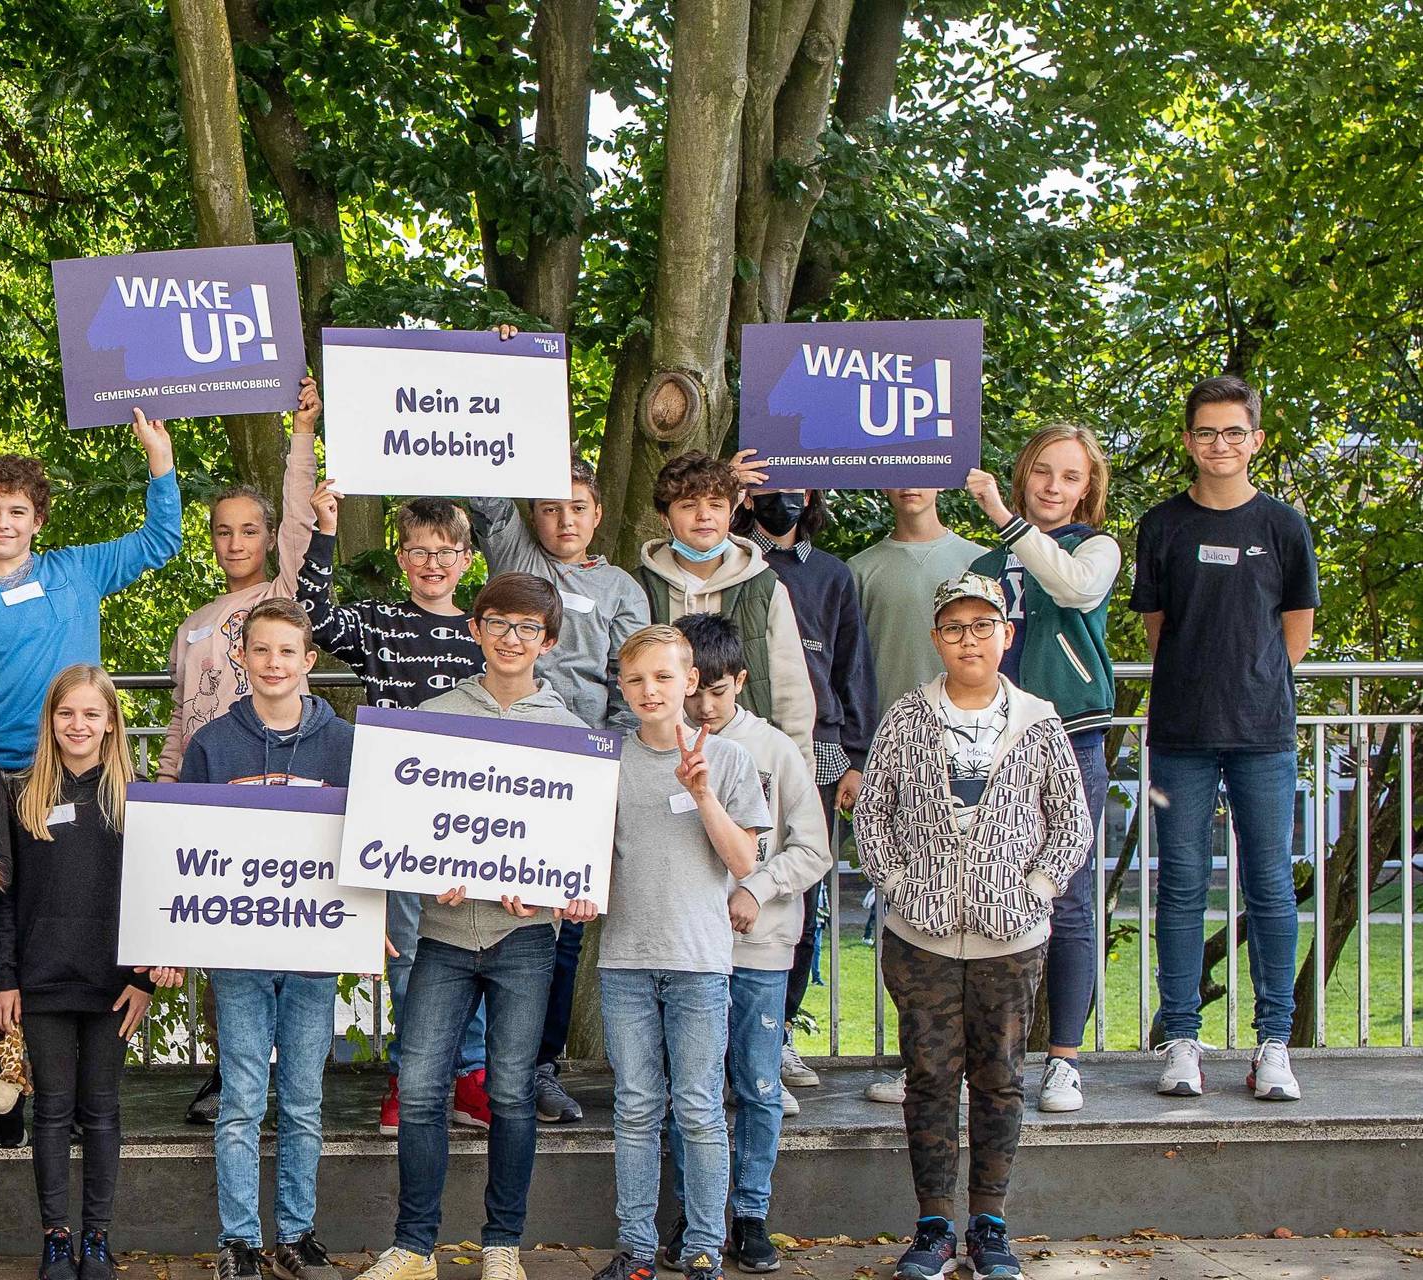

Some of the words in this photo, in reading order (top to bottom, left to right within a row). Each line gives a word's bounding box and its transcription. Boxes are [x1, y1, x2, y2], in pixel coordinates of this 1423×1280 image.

[116, 276, 231, 310] WAKE
[180, 285, 278, 363] UP!
[803, 343, 913, 384] WAKE
[93, 387, 159, 402] GEMEINSAM
[160, 383, 197, 396] GEGEN
[198, 378, 281, 393] CYBERMOBBING
[396, 387, 459, 414] Nein
[468, 397, 500, 415] zu
[859, 358, 953, 437] UP!
[384, 430, 515, 463] Mobbing!
[766, 456, 830, 466] GEMEINSAM
[831, 455, 867, 466] GEGEN
[868, 455, 952, 465] CYBERMOBBING
[1203, 550, 1231, 561] Julian
[378, 647, 475, 668] Champion
[587, 733, 607, 743] WAKE
[596, 739, 614, 753] UP!
[395, 756, 575, 801] Gemeinsam
[433, 813, 526, 845] gegen
[176, 848, 233, 877] Wir
[242, 858, 334, 889] gegen
[359, 839, 592, 901] Cybermobbing!
[169, 894, 348, 930] MOBBING
